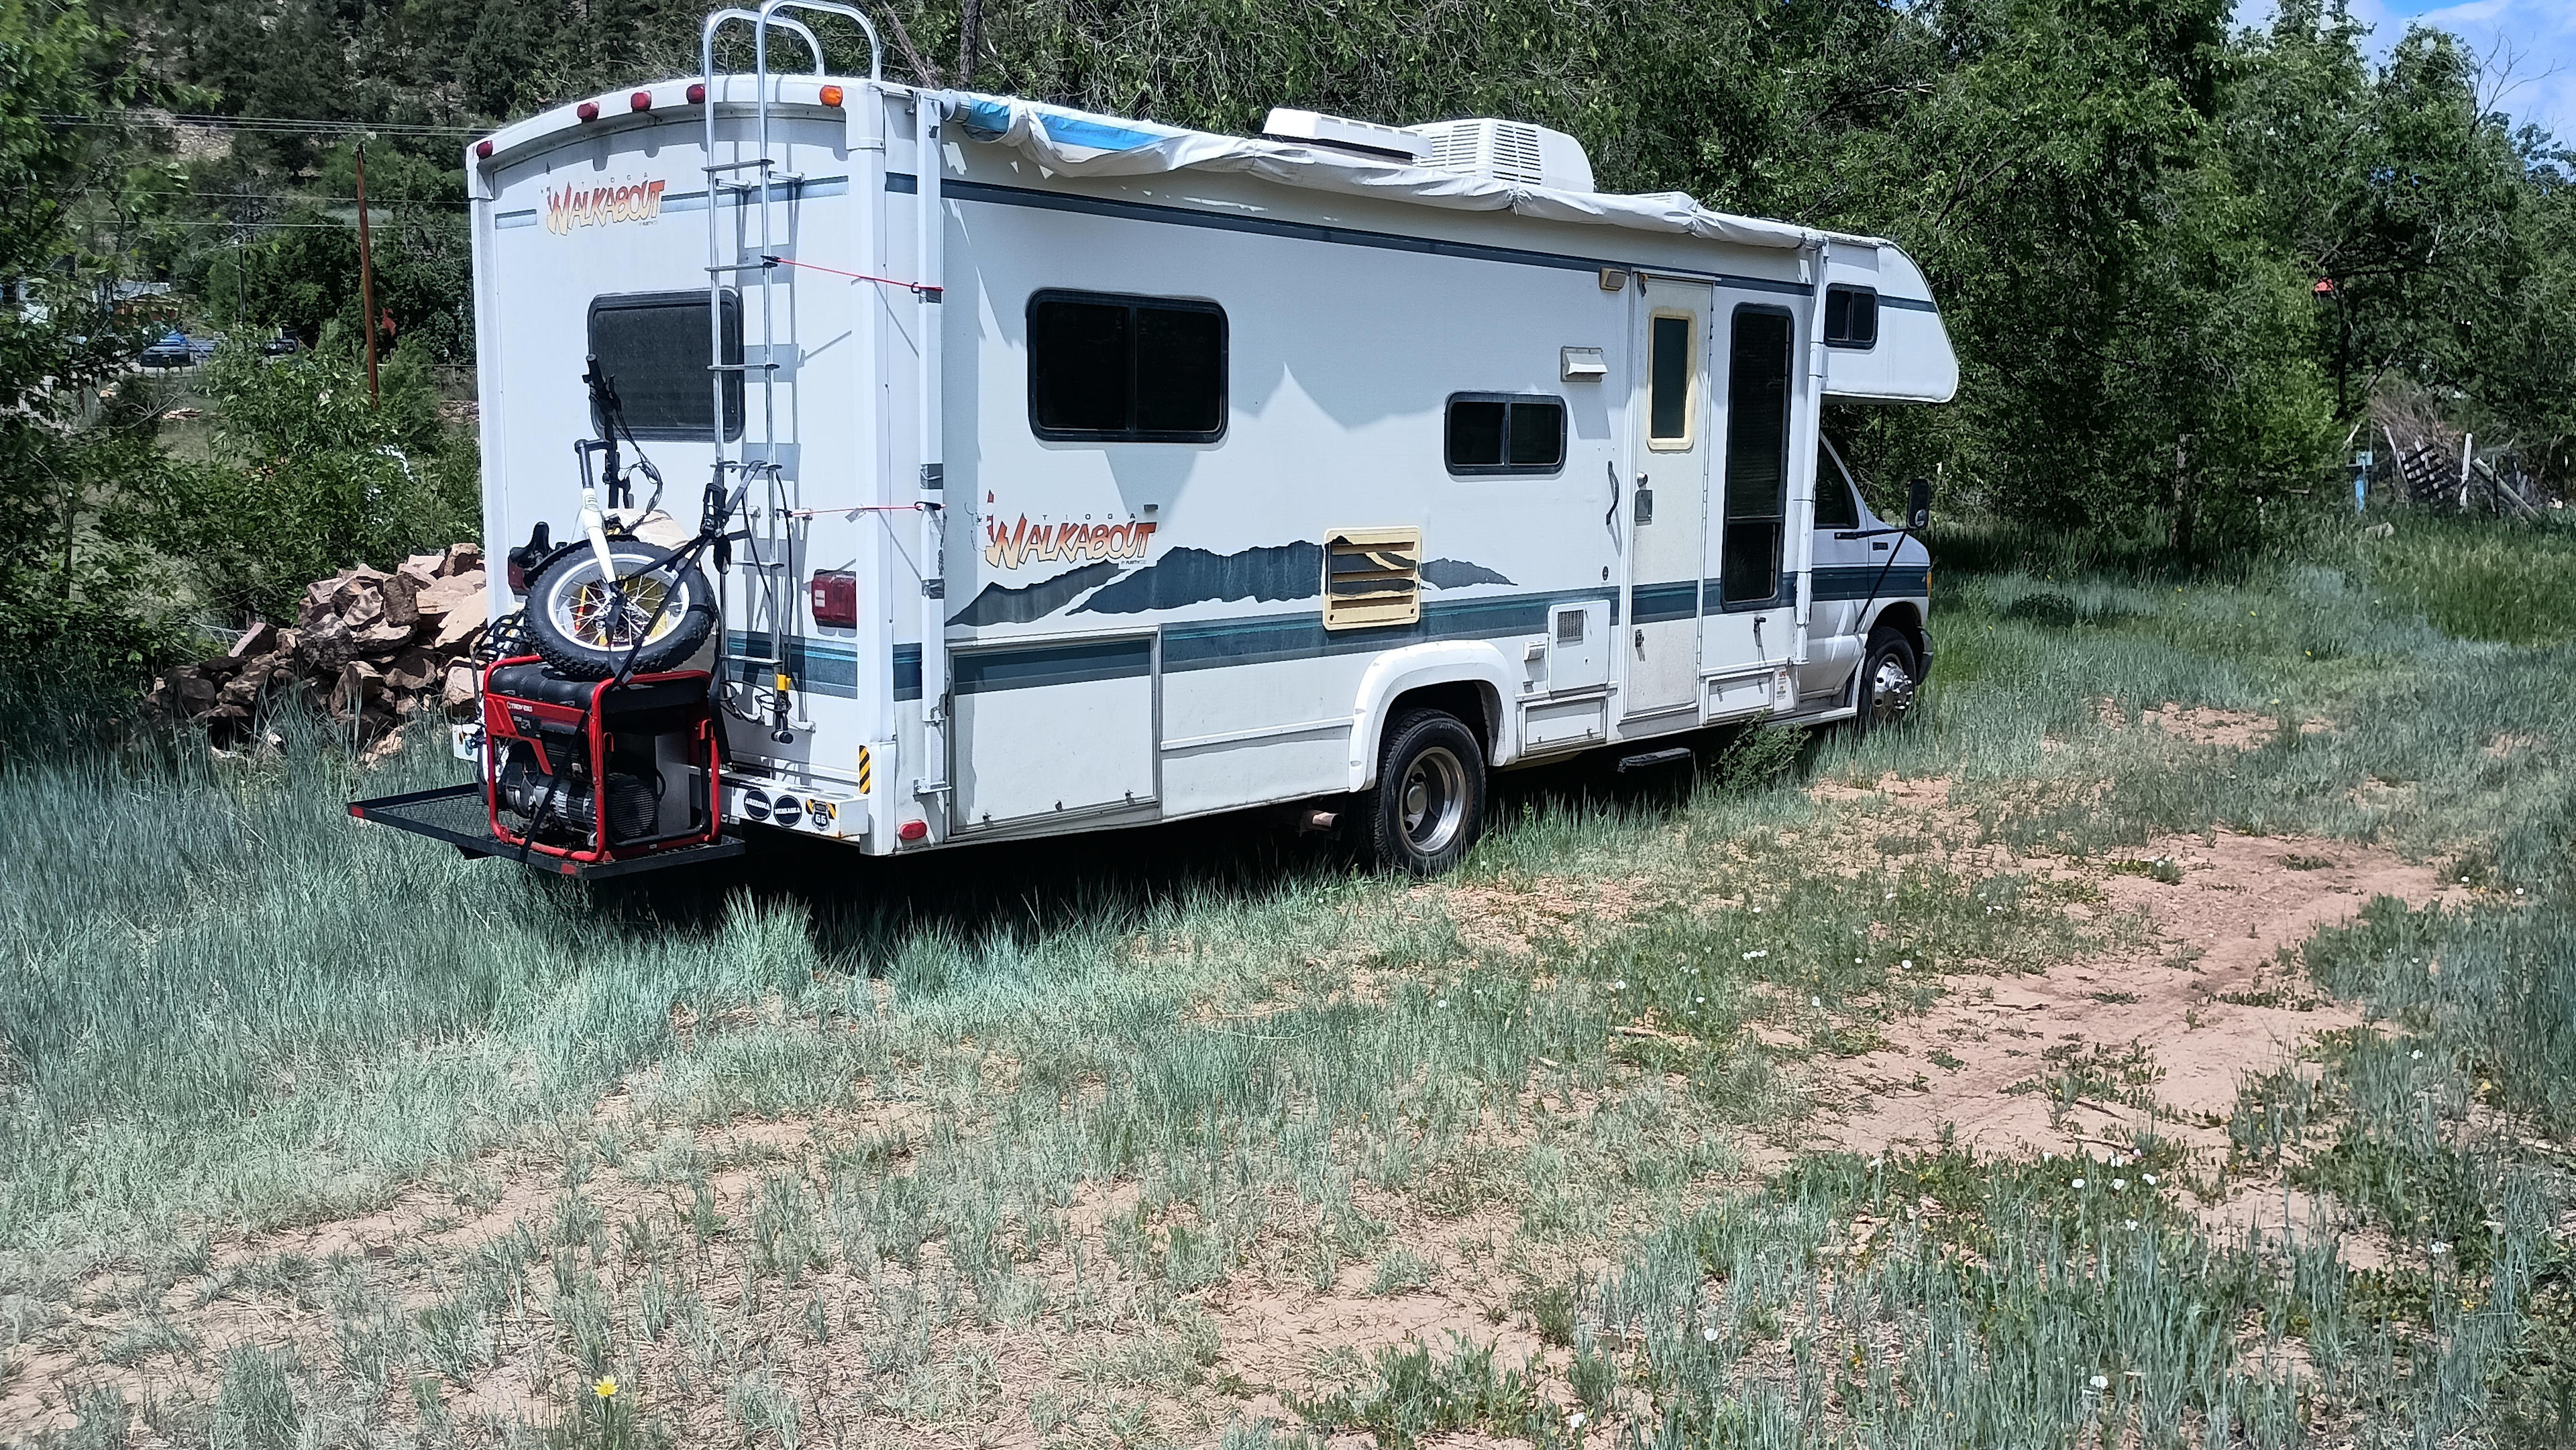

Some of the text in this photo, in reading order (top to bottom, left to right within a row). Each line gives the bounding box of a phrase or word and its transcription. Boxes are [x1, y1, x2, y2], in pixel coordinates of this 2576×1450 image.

[581, 172, 649, 187] TIOGA
[547, 178, 665, 236] WALKABOUT
[1042, 512, 1136, 521] TIOGA
[985, 505, 1157, 570] WALKABOUT
[815, 814, 826, 825] 66
